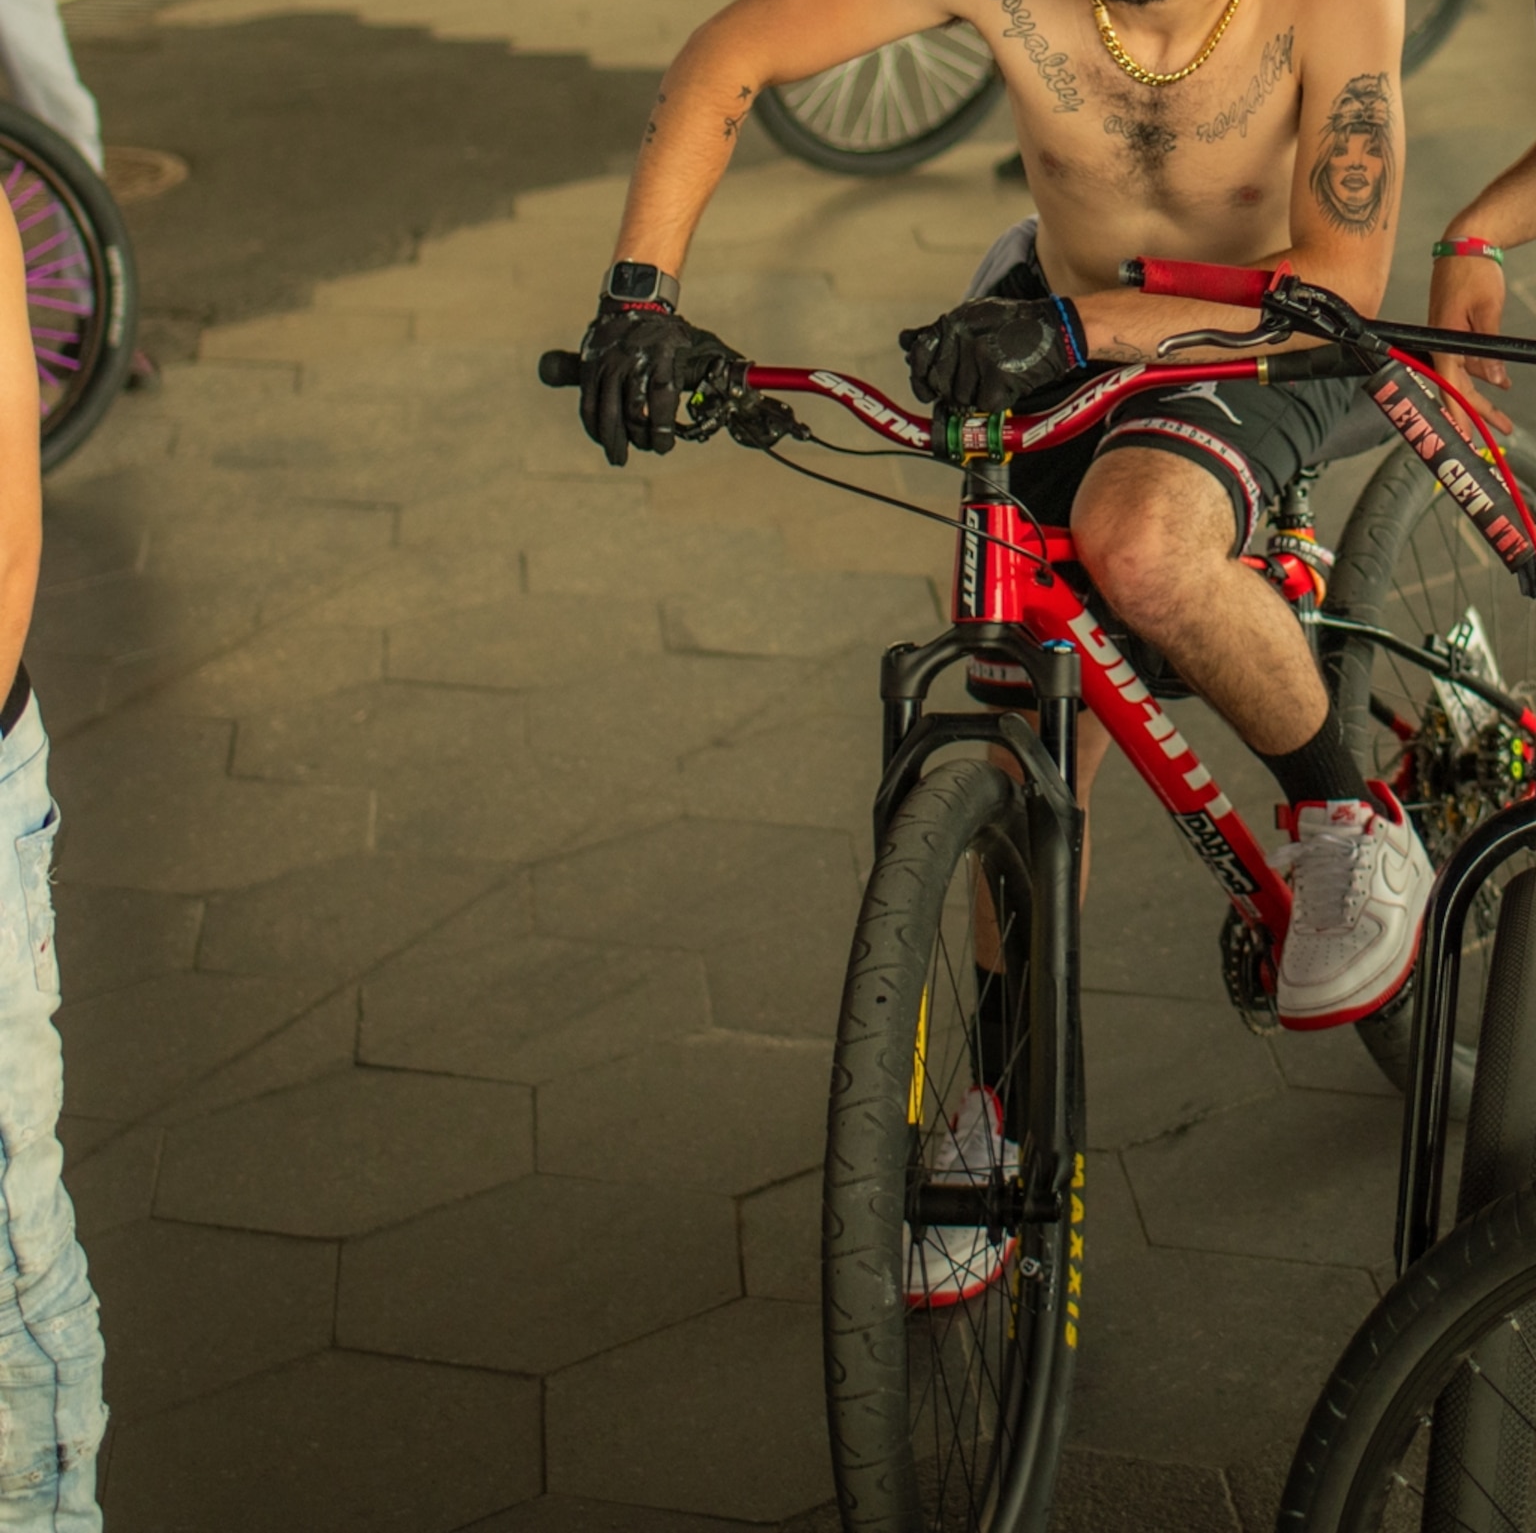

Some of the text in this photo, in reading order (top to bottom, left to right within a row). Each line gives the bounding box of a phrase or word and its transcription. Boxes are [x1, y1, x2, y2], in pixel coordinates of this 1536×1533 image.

[1196, 25, 1295, 144] royalty
[1022, 363, 1147, 448] SPIKE
[1373, 379, 1446, 461] LETS
[1437, 457, 1495, 517] GET
[963, 506, 980, 619] GIANT
[1065, 1151, 1085, 1349] MAXXIS
